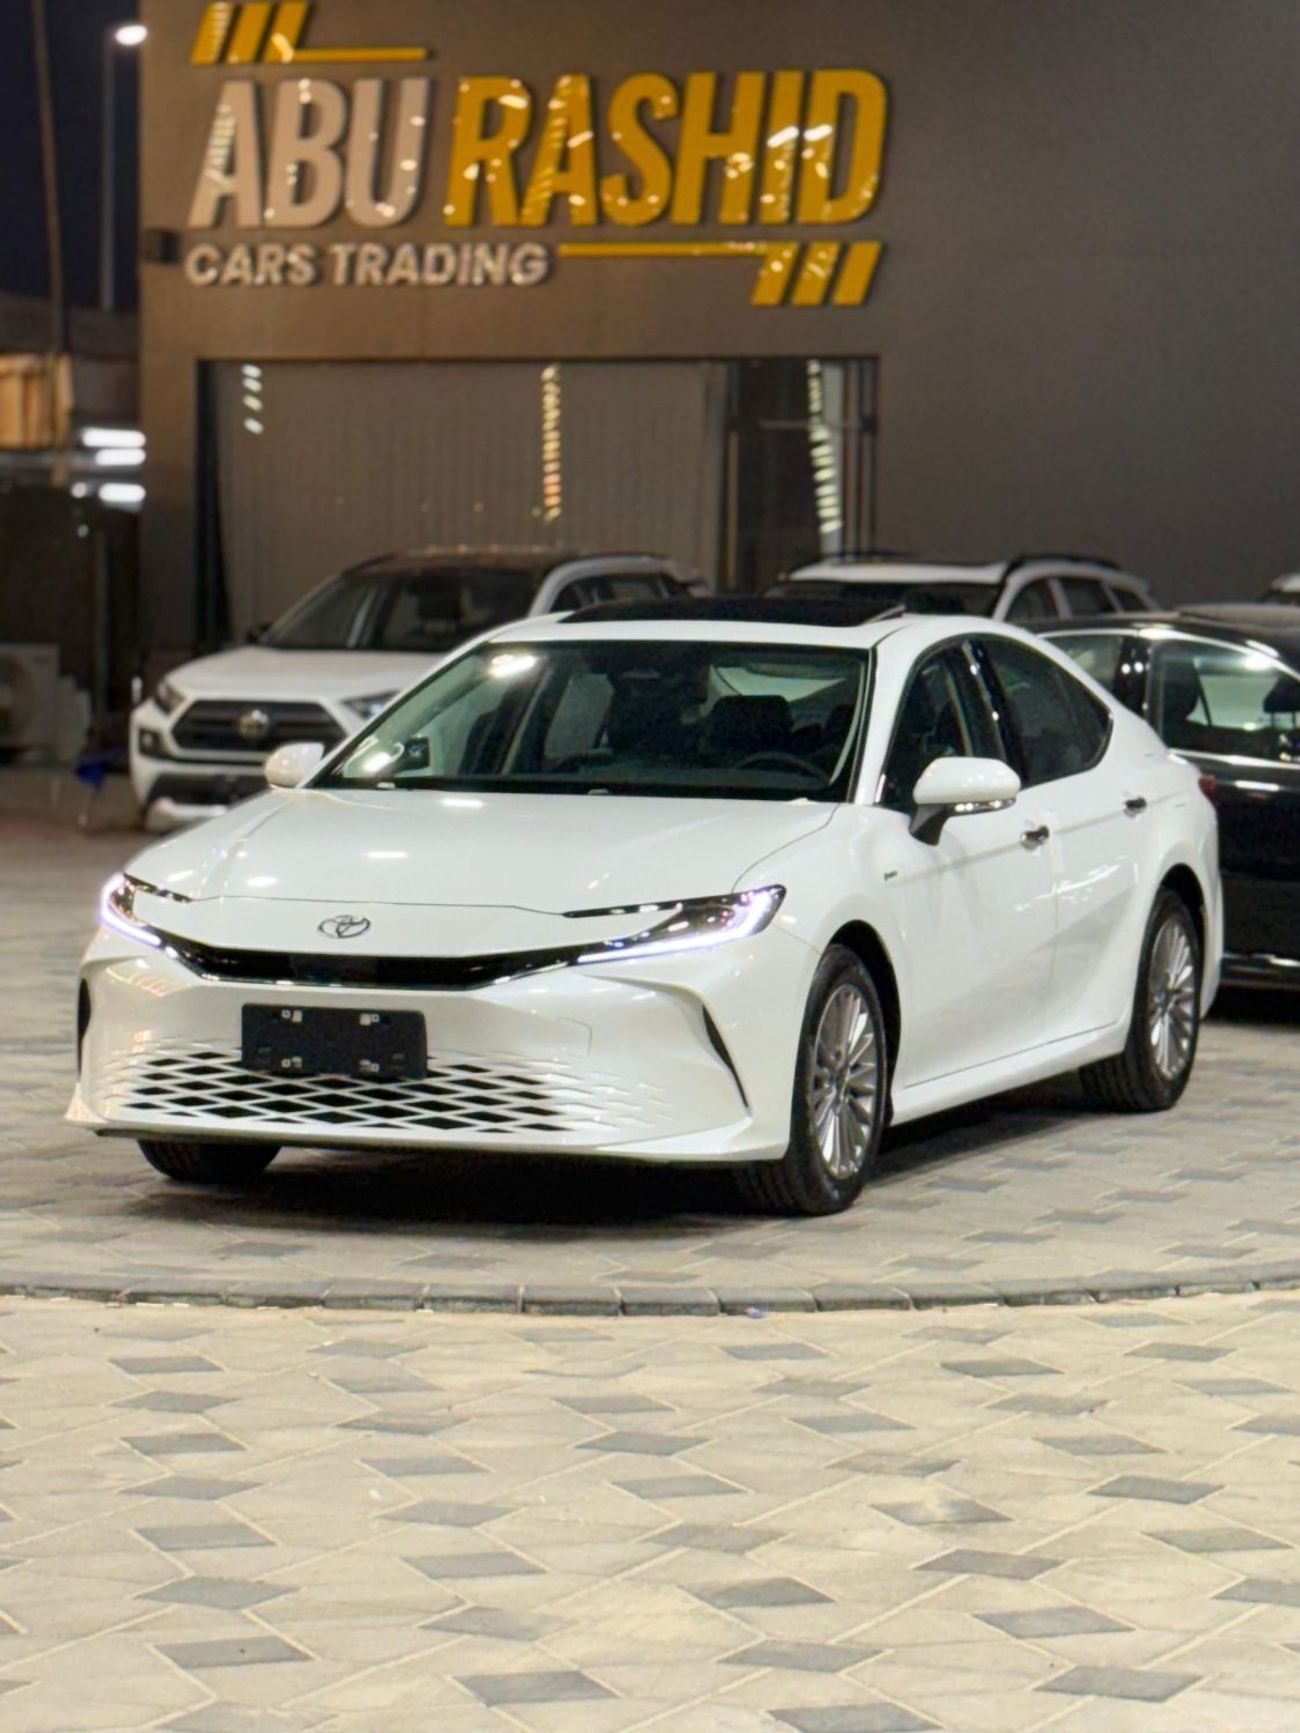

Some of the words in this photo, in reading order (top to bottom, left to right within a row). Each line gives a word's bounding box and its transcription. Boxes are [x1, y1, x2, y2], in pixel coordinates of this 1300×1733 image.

[188, 78, 429, 228] ABU
[443, 69, 888, 227] RASHID
[184, 243, 317, 286] CARS
[330, 242, 549, 286] TRADING
